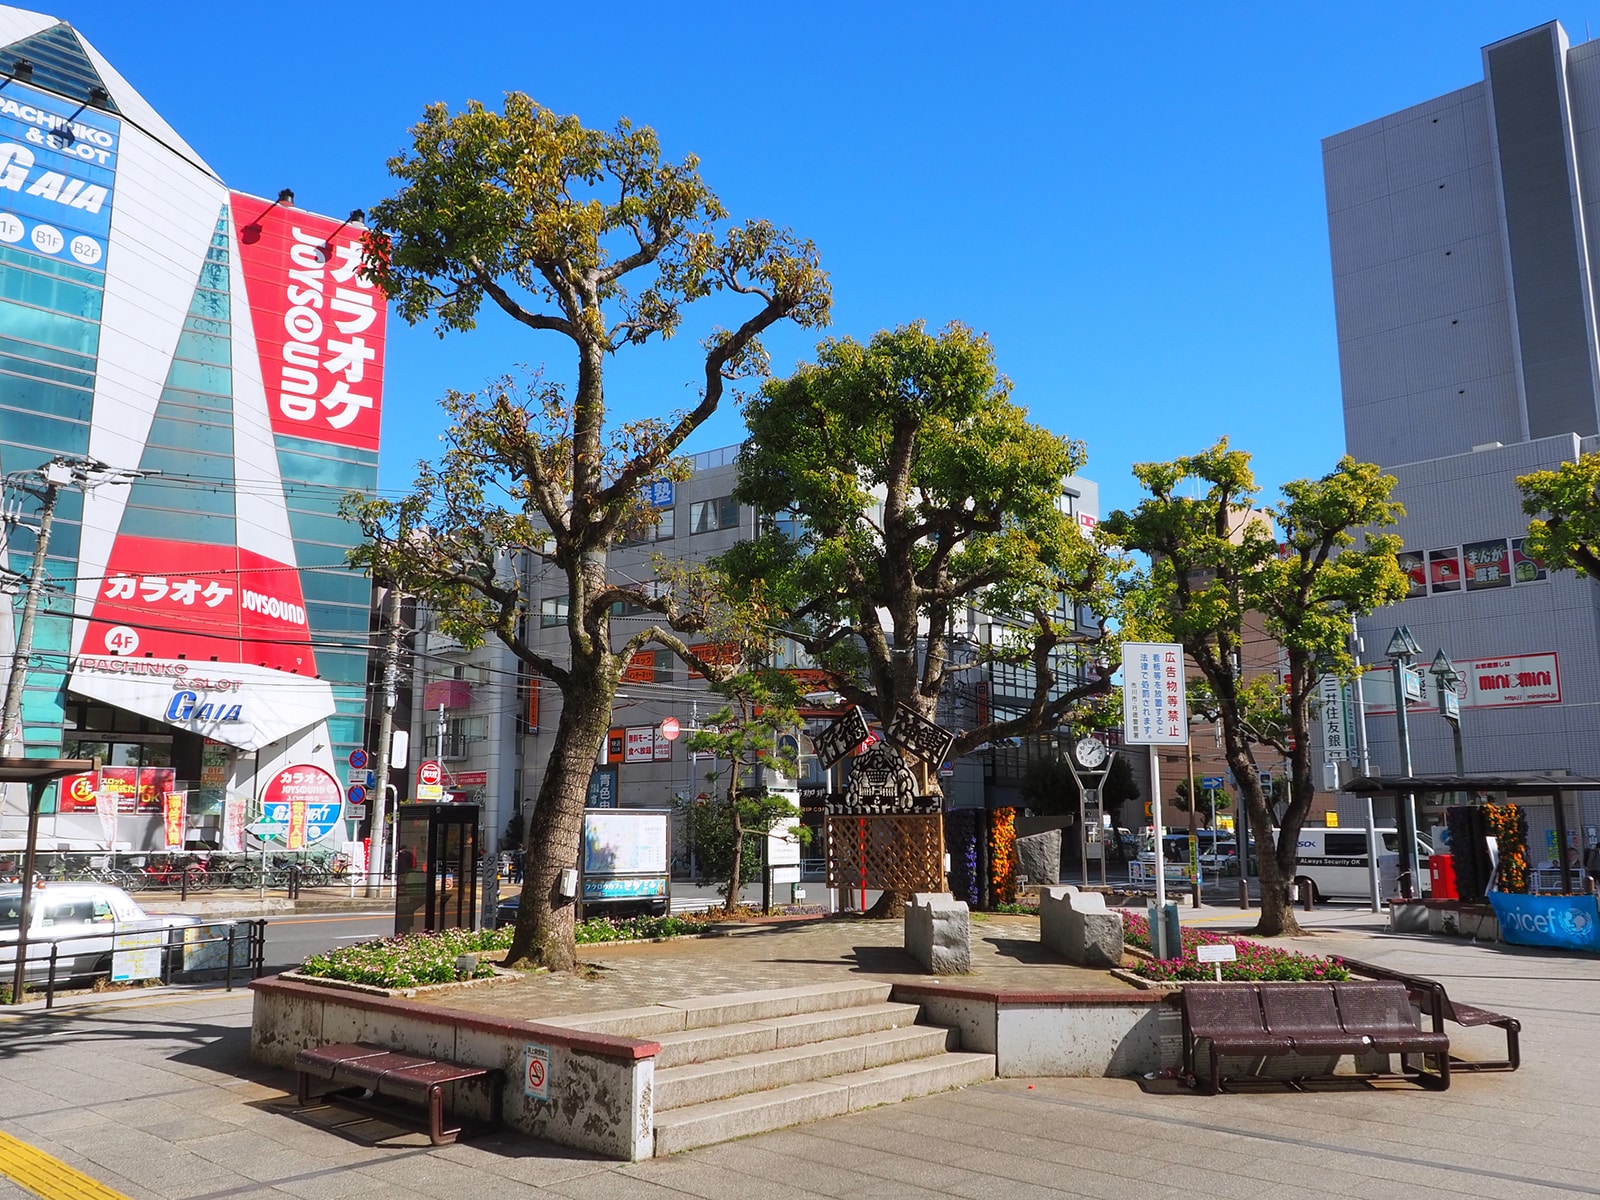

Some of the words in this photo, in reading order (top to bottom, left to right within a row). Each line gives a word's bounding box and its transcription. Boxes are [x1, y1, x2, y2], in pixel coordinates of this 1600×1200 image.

[25, 127, 43, 145] &
[46, 133, 110, 165] SLOT
[0, 142, 108, 214] GAIA
[36, 230, 61, 247] B1F
[74, 242, 98, 258] B2F
[280, 226, 328, 421] JOYSOUND
[320, 241, 378, 430] カラオケ
[1467, 546, 1504, 565] まんが
[105, 573, 233, 608] カラオケ
[242, 588, 305, 625] JOYSOUND
[111, 633, 133, 649] 4F
[82, 657, 189, 675] PACHINKO
[192, 677, 244, 691] SLOT
[1479, 673, 1510, 690] mini
[1518, 670, 1551, 687] mini
[1153, 654, 1164, 735] 看板等を放置すると
[1165, 652, 1179, 737] 広告物等禁止
[165, 691, 243, 722] GAIA
[280, 772, 328, 784] カラオケ
[282, 786, 325, 794] JOYSOUND
